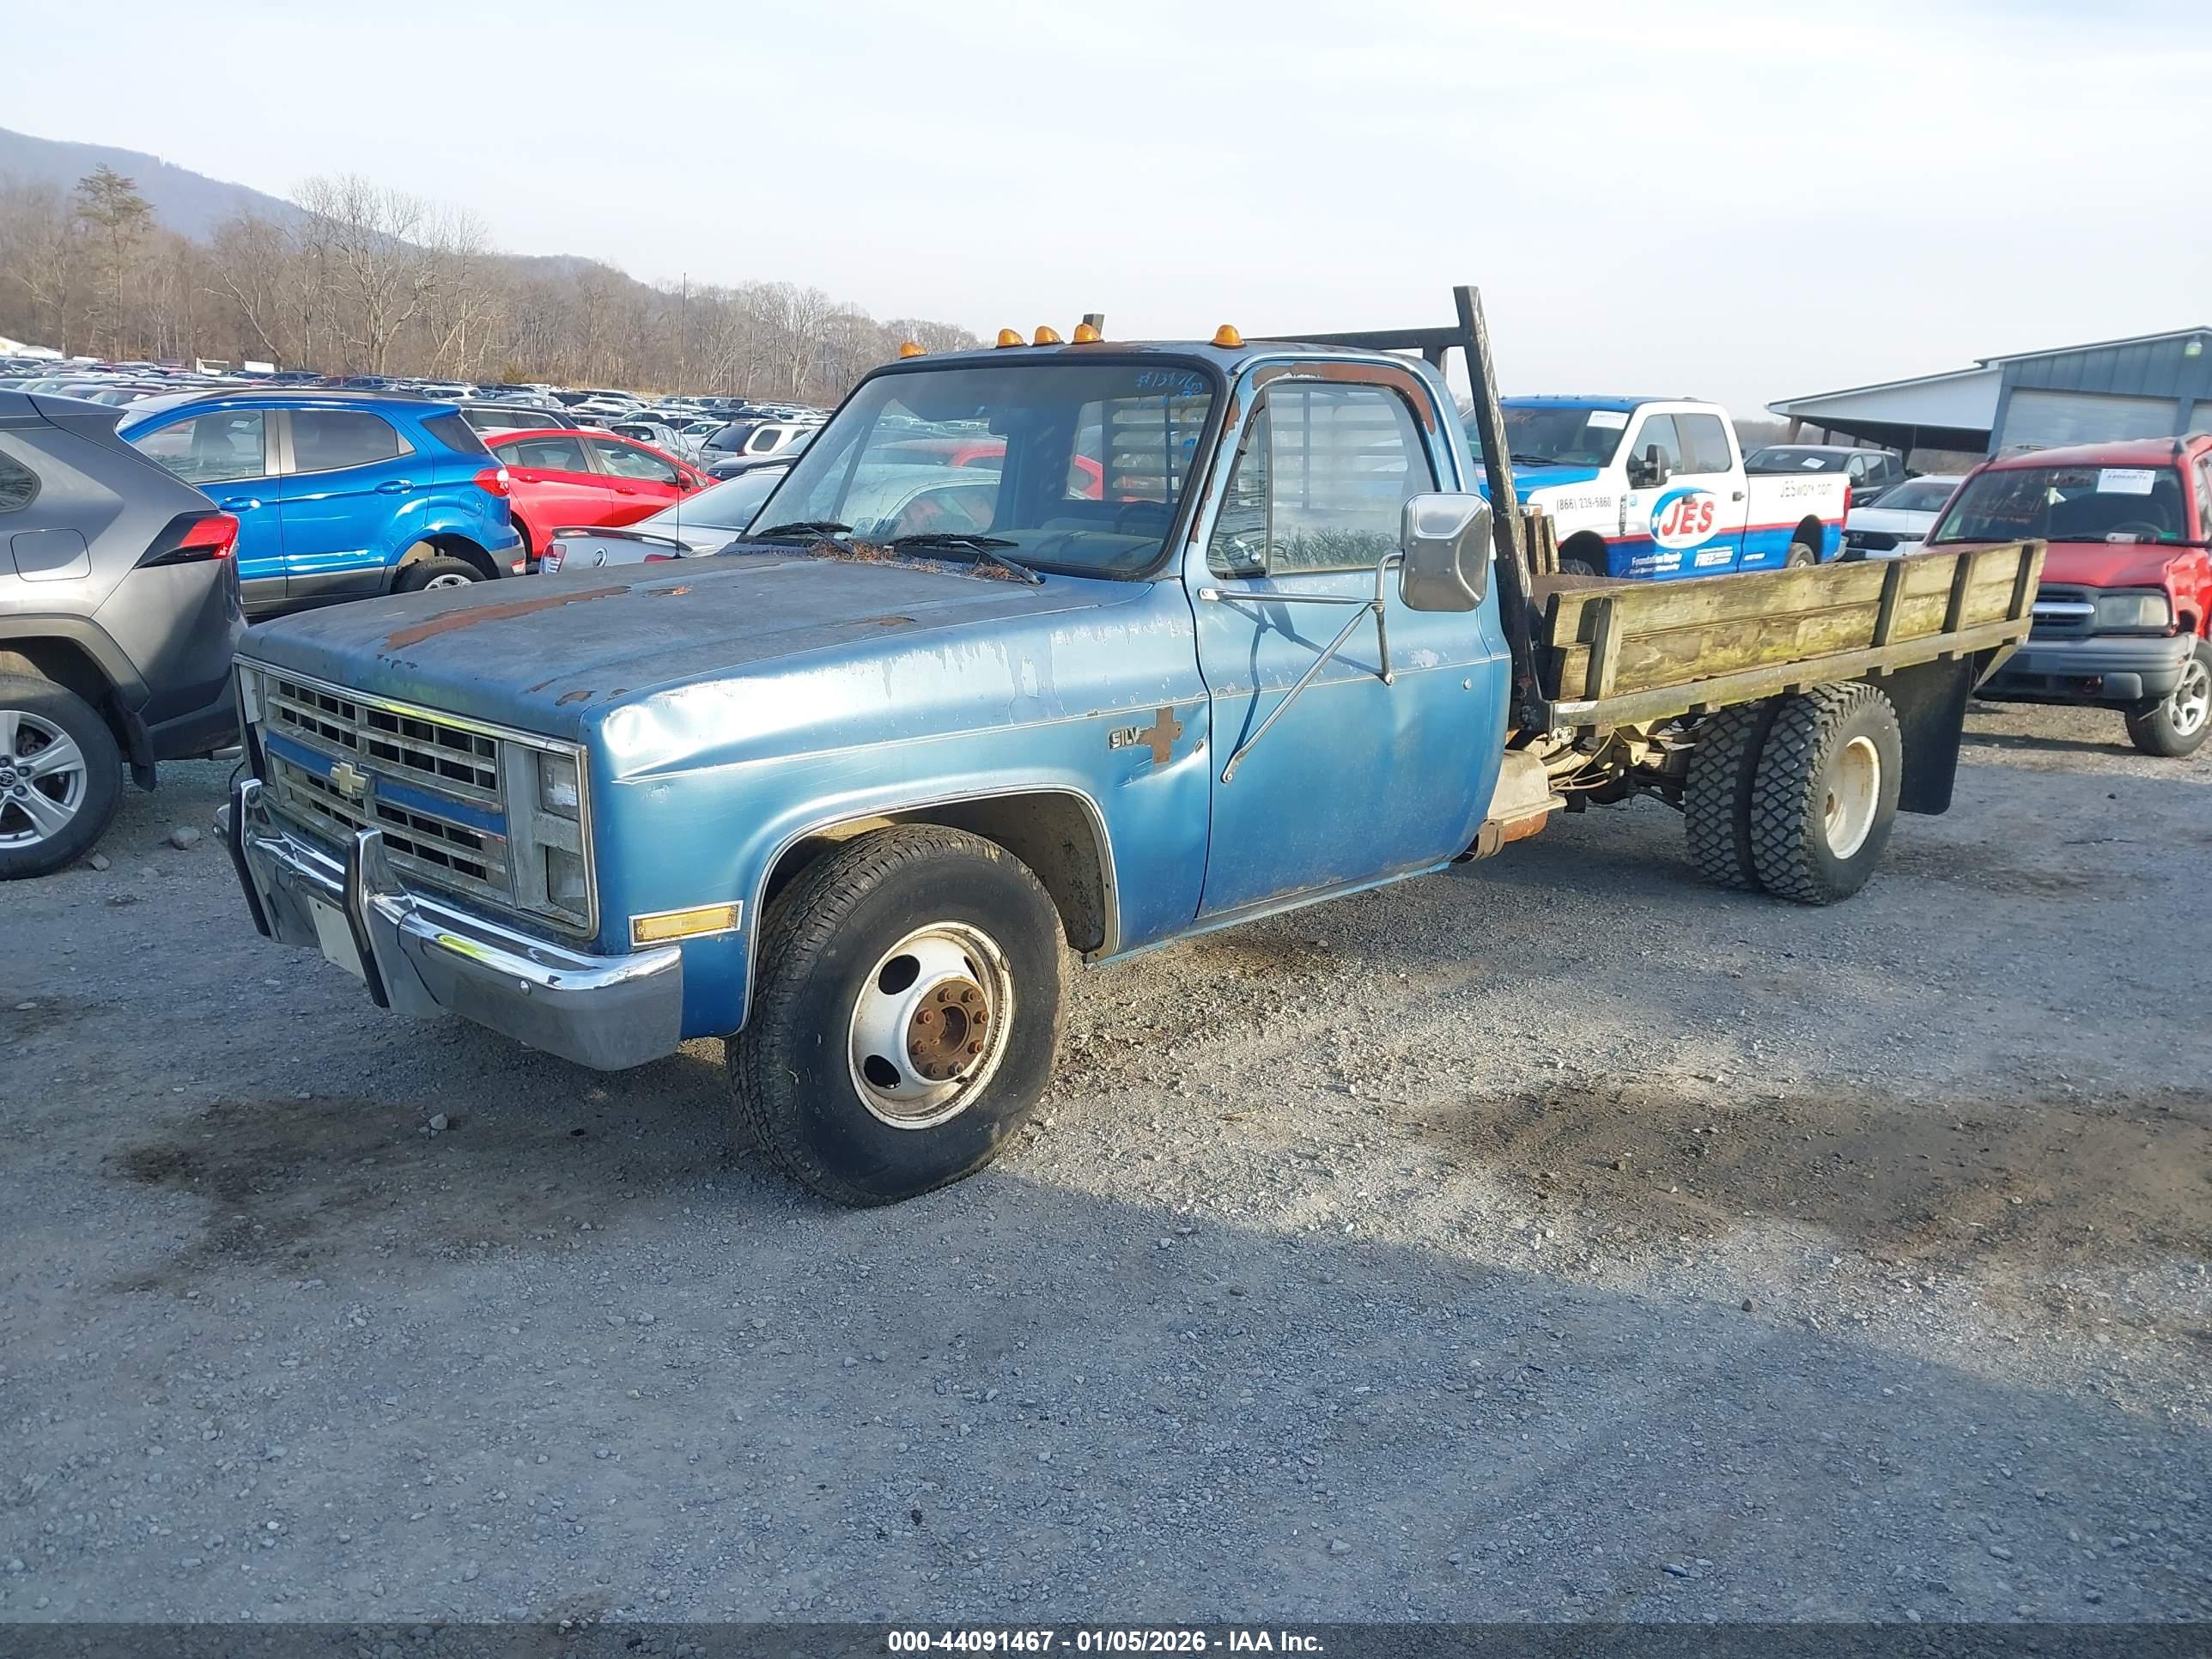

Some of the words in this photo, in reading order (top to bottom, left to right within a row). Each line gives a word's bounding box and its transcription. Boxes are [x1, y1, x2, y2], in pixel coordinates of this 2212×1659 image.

[1779, 479, 1834, 498] JESworcom
[1556, 498, 1577, 514] (866)
[1662, 500, 1715, 536] JES
[1109, 726, 1140, 749] SILV
